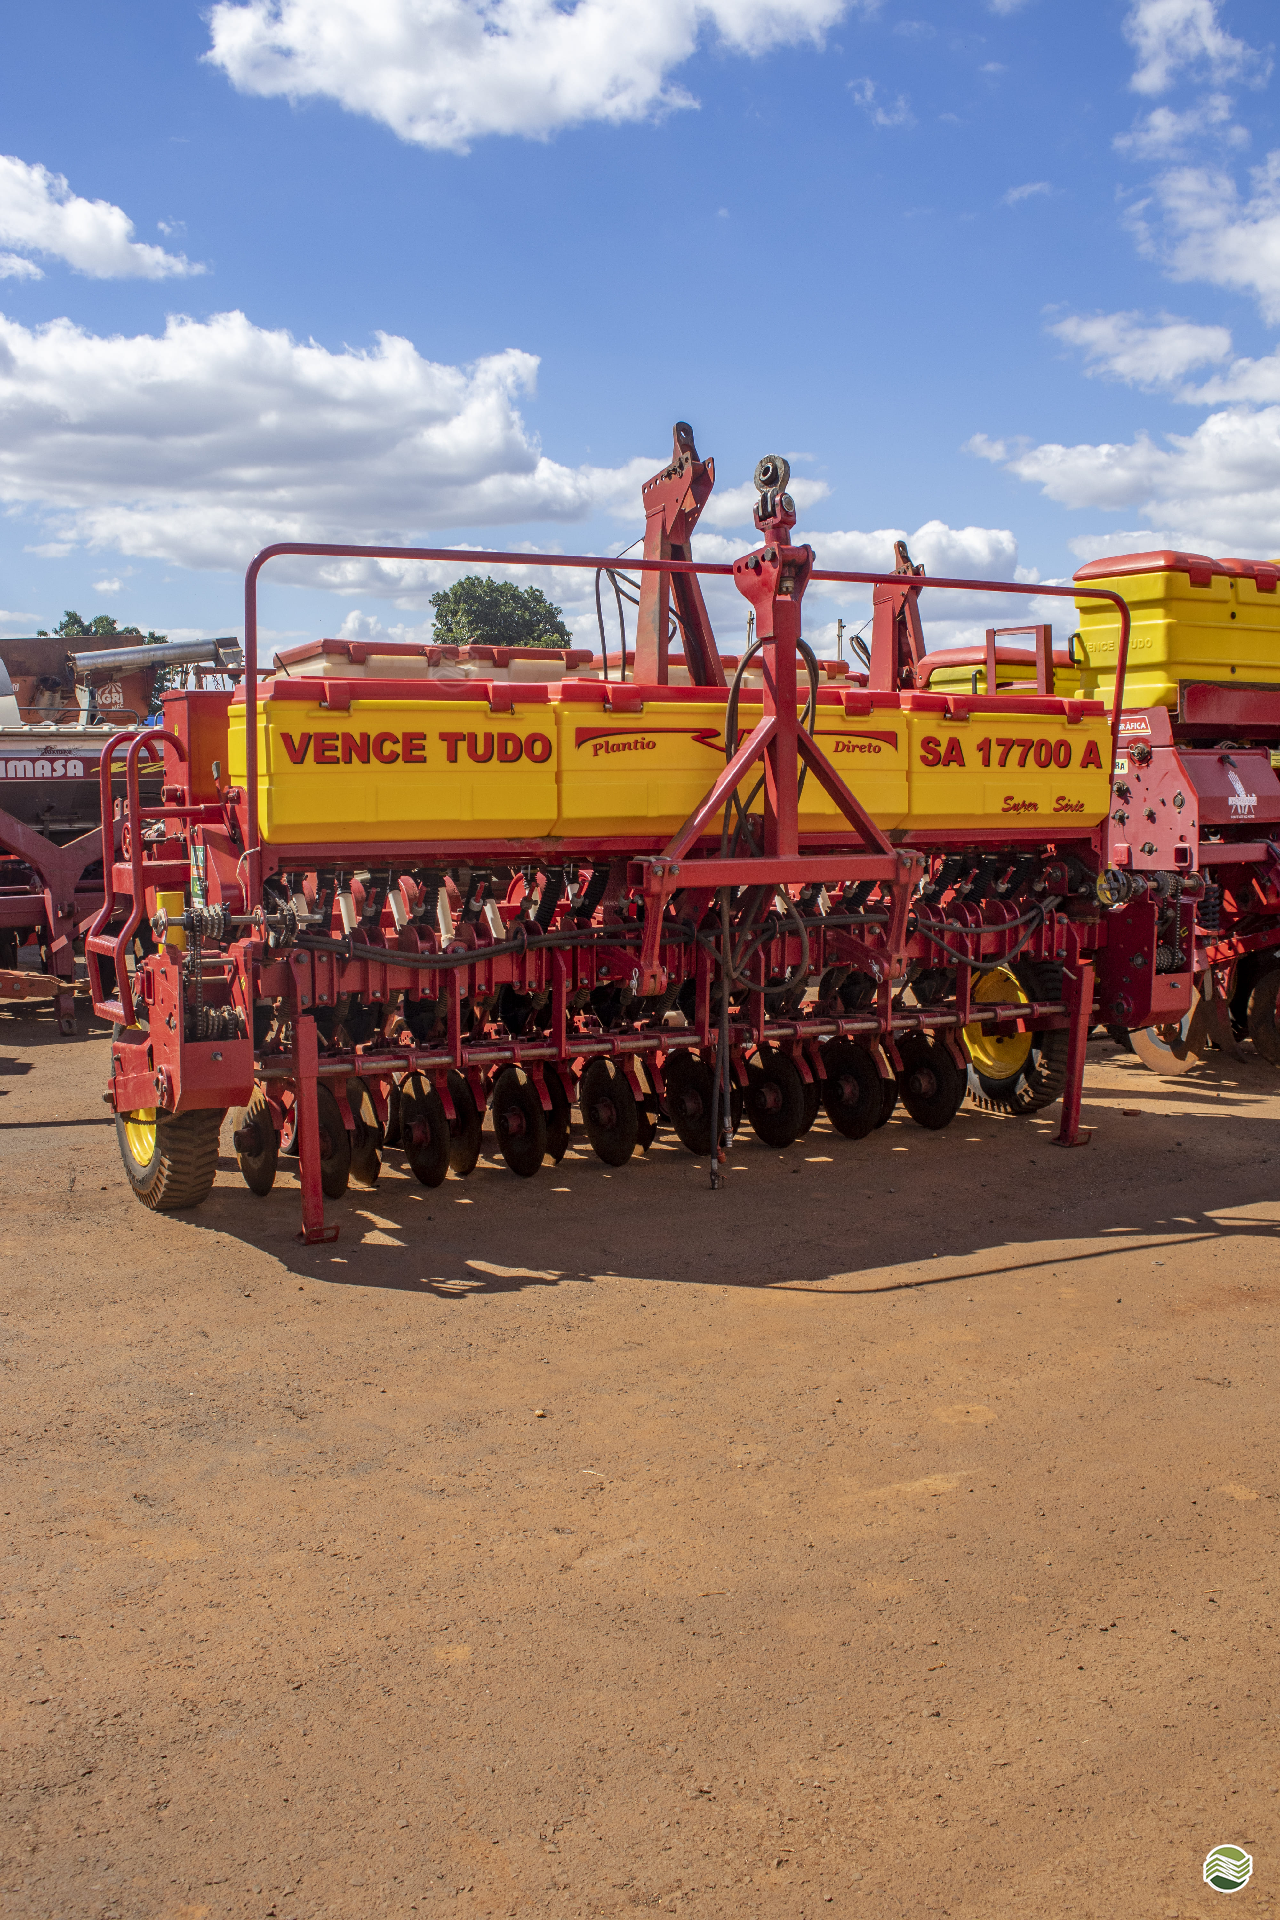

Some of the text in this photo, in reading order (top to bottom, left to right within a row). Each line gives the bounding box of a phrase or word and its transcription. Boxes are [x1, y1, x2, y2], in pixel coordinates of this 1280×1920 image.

[1129, 637, 1153, 650] UDO
[280, 731, 552, 764] VENCE TUDO
[591, 736, 657, 757] Plantio
[832, 740, 882, 754] Direto
[920, 736, 1103, 769] SA 17700 A
[1001, 795, 1039, 815] Super
